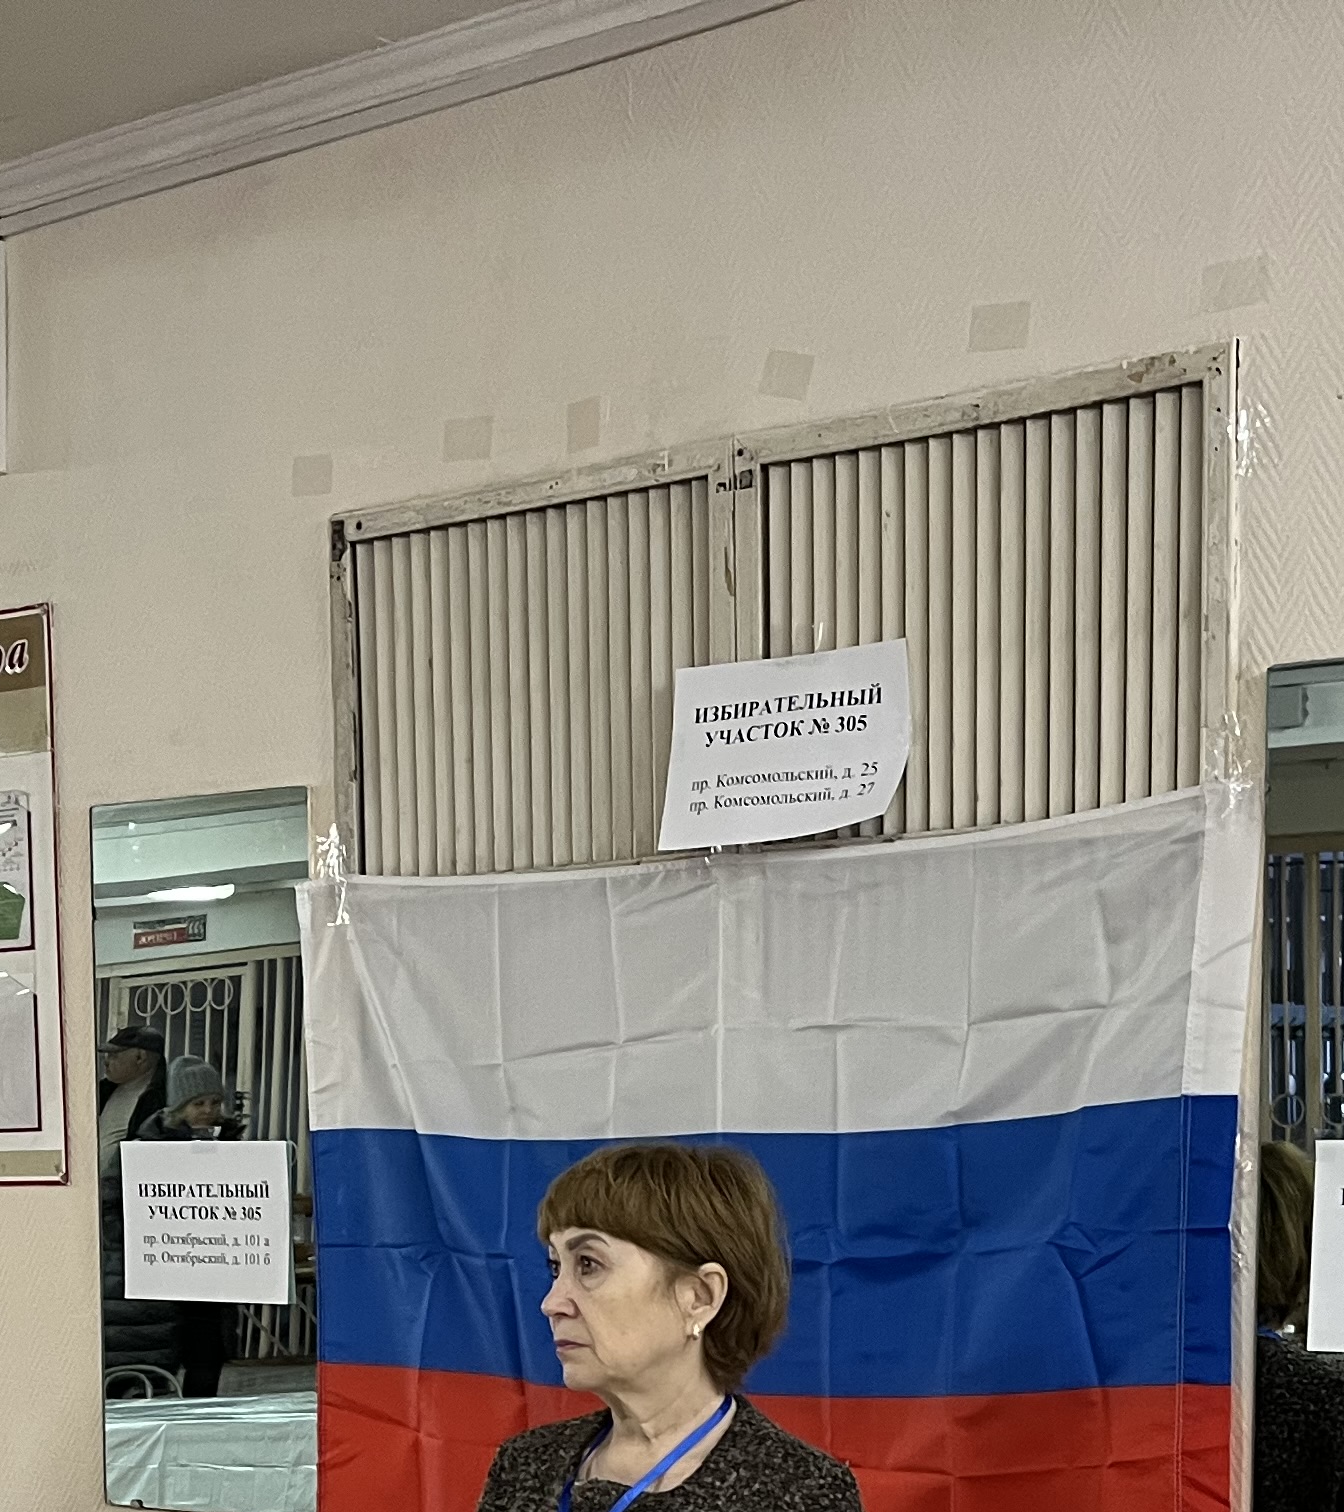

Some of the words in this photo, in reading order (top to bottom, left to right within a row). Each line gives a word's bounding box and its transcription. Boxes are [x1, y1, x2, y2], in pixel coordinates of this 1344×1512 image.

[694, 683, 883, 724] ИЗБИРАТЕЛЬНЫЙ
[705, 719, 805, 748] УЧАСТОК
[808, 717, 830, 735] №
[835, 714, 868, 734] 305
[691, 780, 712, 794] пр.
[716, 765, 838, 788] Комсомольский,
[860, 761, 878, 777] 25
[689, 800, 709, 815] пр.
[713, 787, 835, 809] Комсомольский,
[857, 781, 875, 796] 27
[138, 1180, 270, 1199] ИЗБИРАТЕЛЬНЫЙ
[148, 1205, 220, 1220] УЧАСТОК
[222, 1206, 237, 1221] №
[240, 1206, 262, 1221] 305
[143, 1234, 157, 1246] пр.
[244, 1234, 260, 1246] 101
[143, 1252, 157, 1265] пр.
[244, 1252, 260, 1265] 101
